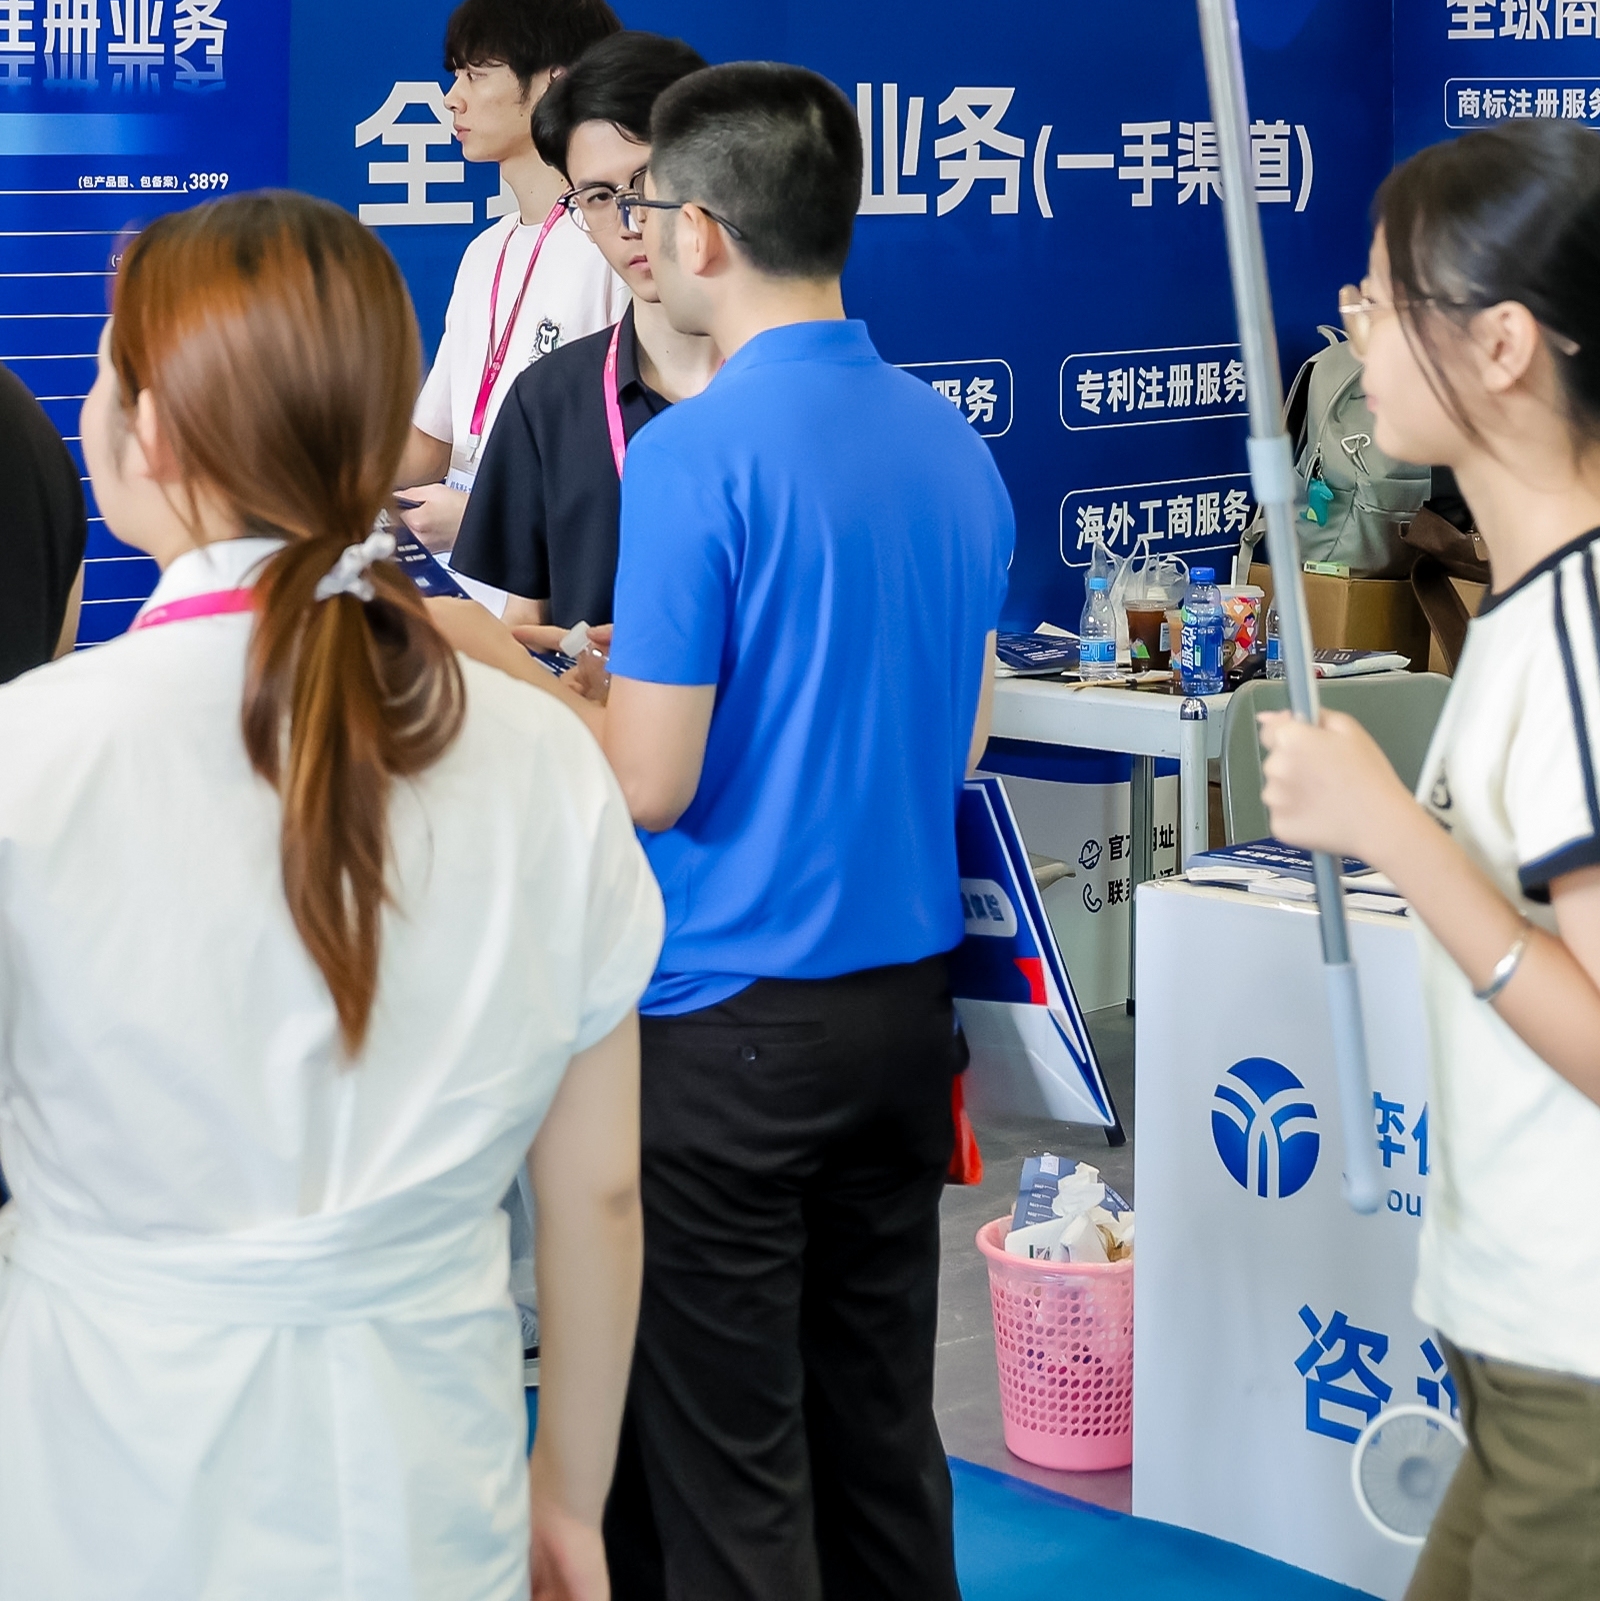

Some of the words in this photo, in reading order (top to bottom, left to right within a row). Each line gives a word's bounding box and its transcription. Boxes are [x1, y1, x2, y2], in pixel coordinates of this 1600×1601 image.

[188, 172, 229, 190] 3899
[1076, 359, 1247, 415] 专利注册服务
[1076, 488, 1251, 551] 海外工商服务
